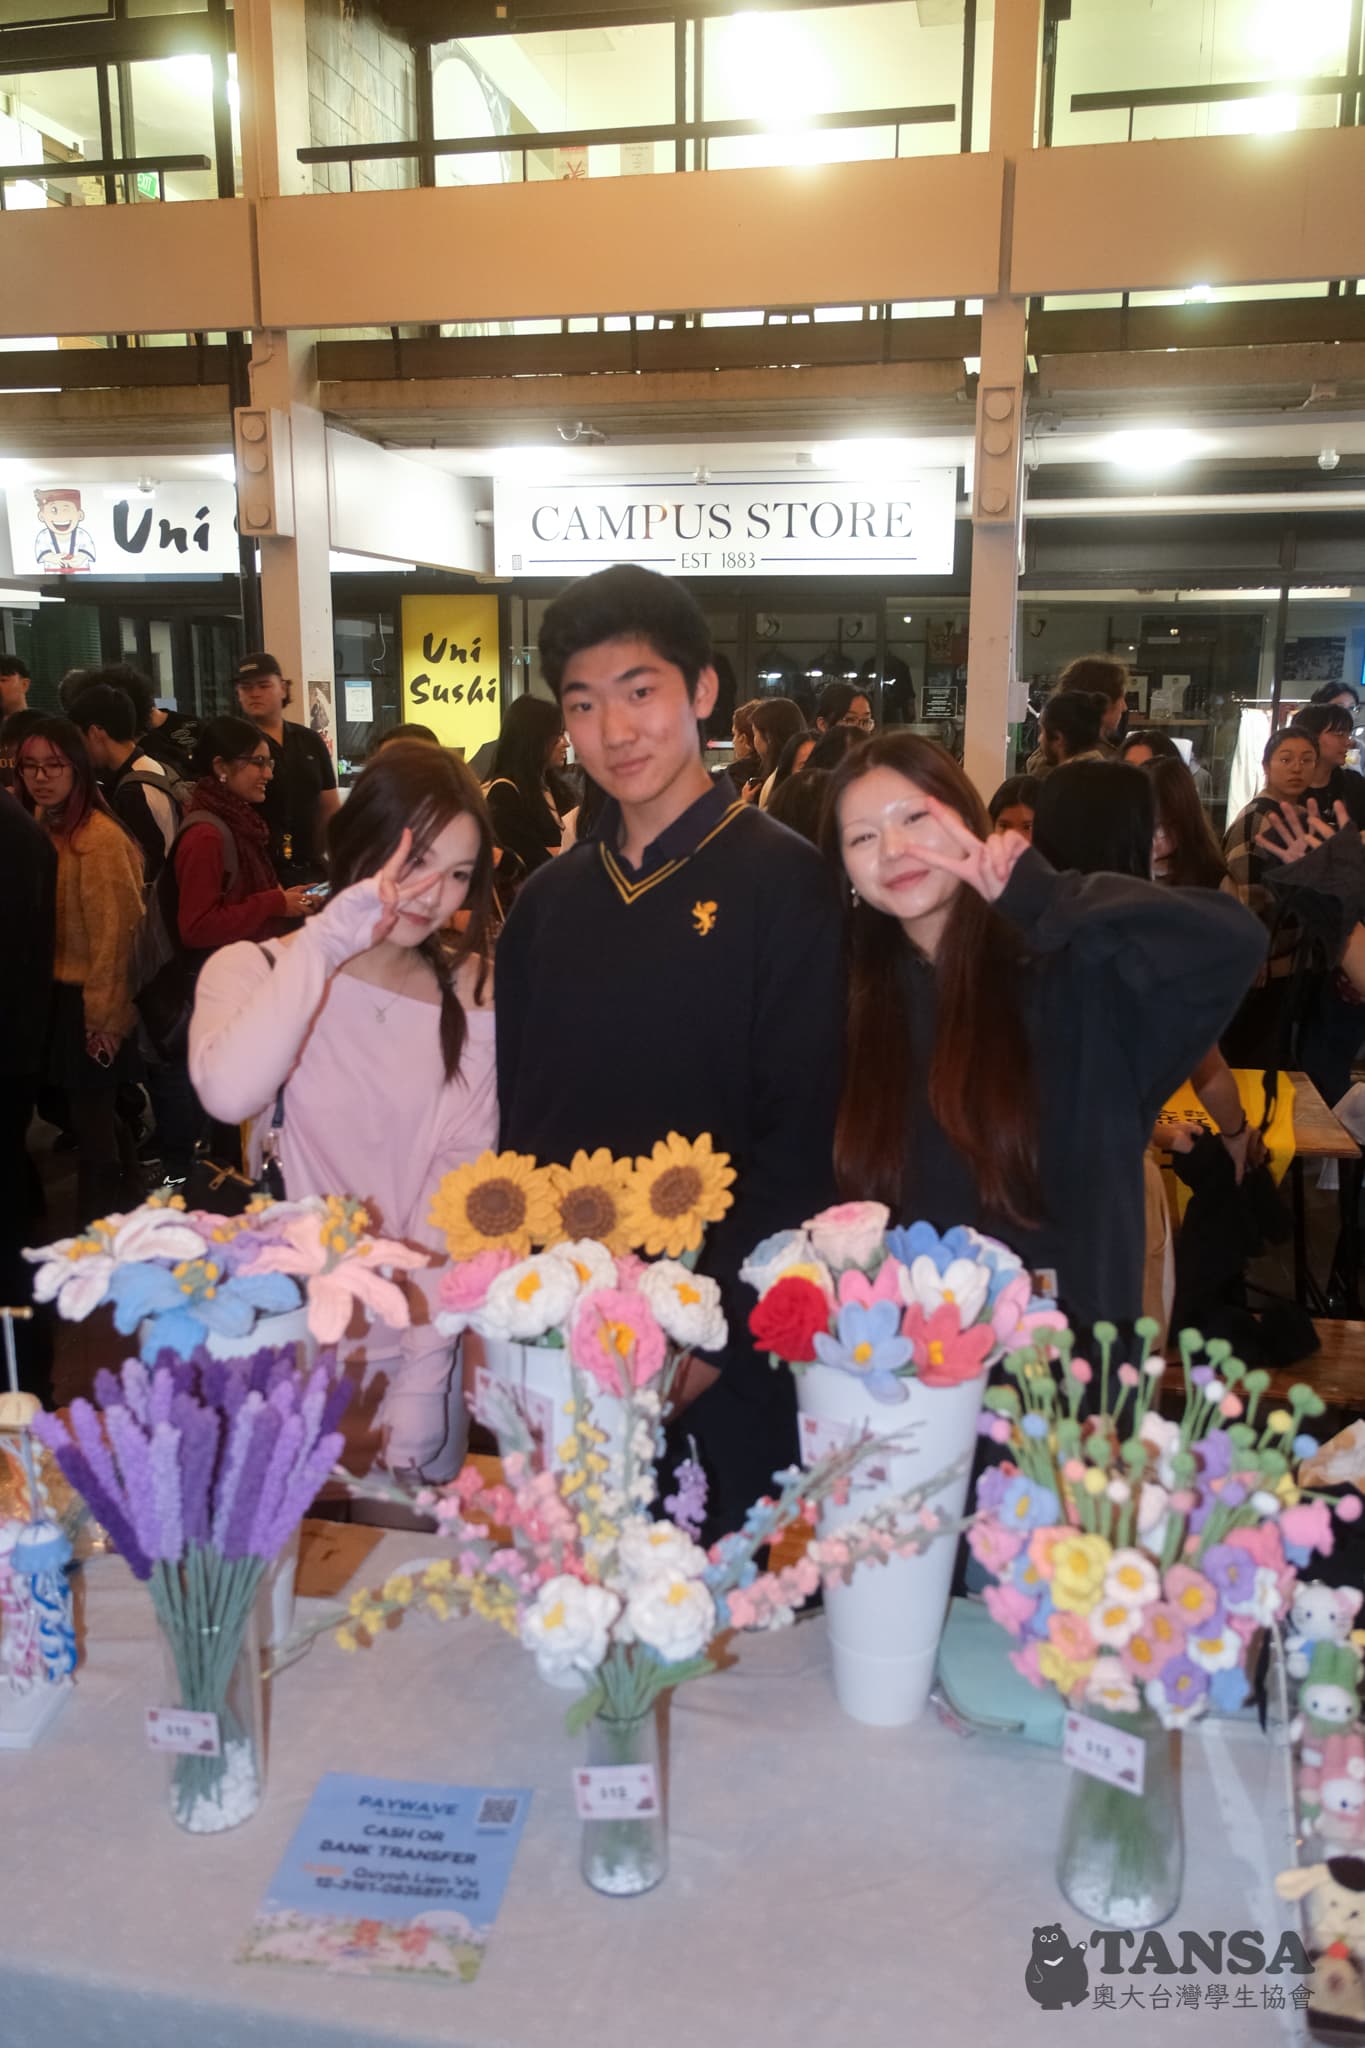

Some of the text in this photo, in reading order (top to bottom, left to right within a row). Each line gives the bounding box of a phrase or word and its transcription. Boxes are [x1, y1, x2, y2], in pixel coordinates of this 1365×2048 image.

[113, 500, 210, 553] Uni
[531, 501, 913, 541] CAMPUS STORE
[681, 552, 756, 569] EST 1883
[422, 632, 481, 664] Uni
[410, 673, 497, 706] Sushi
[358, 1795, 459, 1816] PAYWAVE
[363, 1824, 445, 1842] CASH OR
[319, 1839, 478, 1865] BANK TRANSFER
